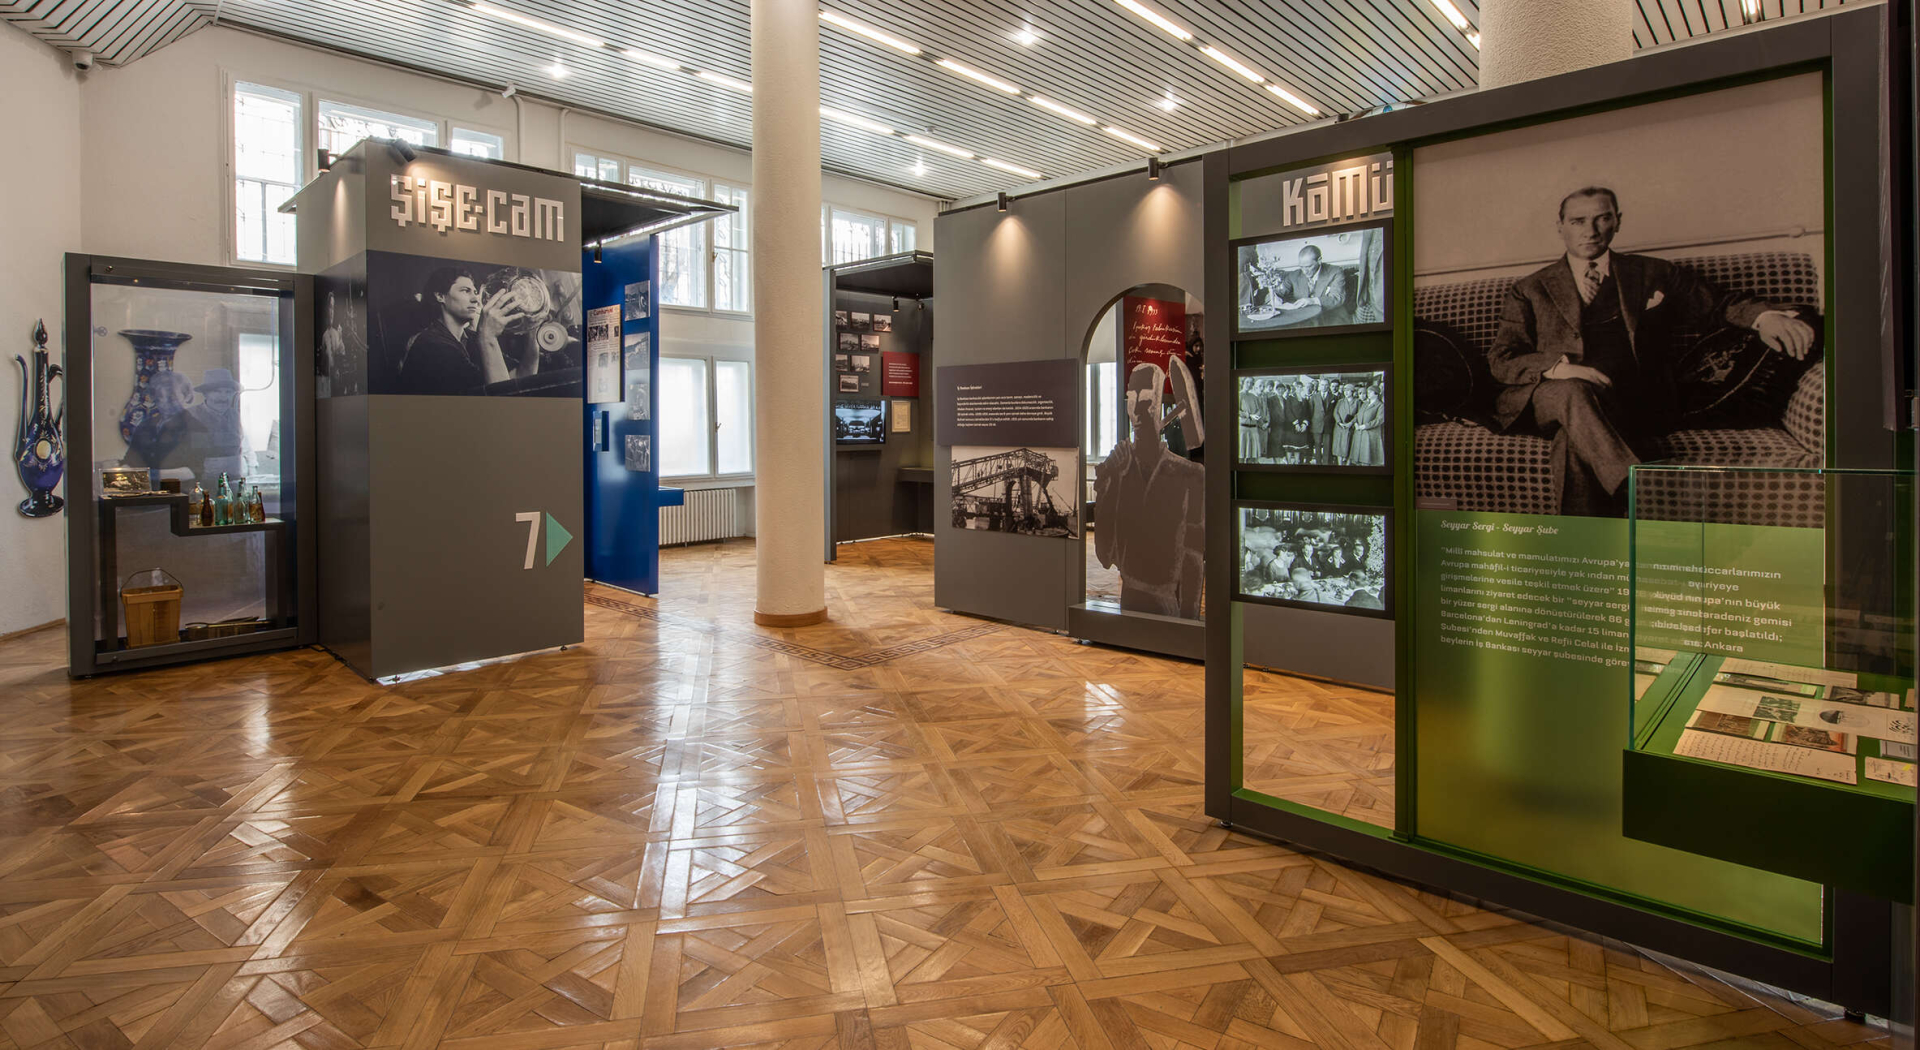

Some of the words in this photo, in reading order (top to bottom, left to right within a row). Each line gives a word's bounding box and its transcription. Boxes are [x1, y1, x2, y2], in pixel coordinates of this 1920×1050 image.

[516, 512, 540, 569] 7
[1440, 520, 1470, 531] Seyyar
[1472, 521, 1495, 533] Sergi
[1502, 523, 1535, 535] Seyyar
[1536, 525, 1559, 536] Şube
[1464, 549, 1504, 558] mahsulat
[1441, 560, 1470, 569] Avrupa
[1511, 565, 1567, 578] ticariyesiyle
[1440, 584, 1484, 595] limanlarını
[1486, 590, 1516, 600] ziyaret
[1517, 593, 1550, 602] edecek
[1552, 595, 1564, 604] bir
[1753, 616, 1792, 627] gemisi
[1440, 597, 1451, 605] bir
[1453, 599, 1475, 608] yüzer
[1477, 603, 1498, 612] sergi
[1500, 604, 1533, 614] alanına
[1496, 577, 1522, 586] vesile
[1524, 580, 1550, 589] teşkil
[1552, 583, 1581, 592] etmek
[1745, 598, 1781, 610] büyük
[1440, 610, 1502, 624] Barcelona'dan
[1503, 617, 1557, 631] Leningrad'a
[1559, 623, 1586, 634] kadar
[1587, 627, 1599, 635] 15
[1704, 641, 1744, 652] Ankara
[1495, 629, 1537, 642] Muvaffak
[1538, 635, 1549, 643] ve
[1574, 639, 1599, 649] Celal
[1601, 642, 1613, 651] ile
[1440, 635, 1474, 647] beylerin
[1486, 642, 1520, 653] Bankası
[1521, 647, 1552, 658] seyyar
[1553, 651, 1603, 664] şubesinde
